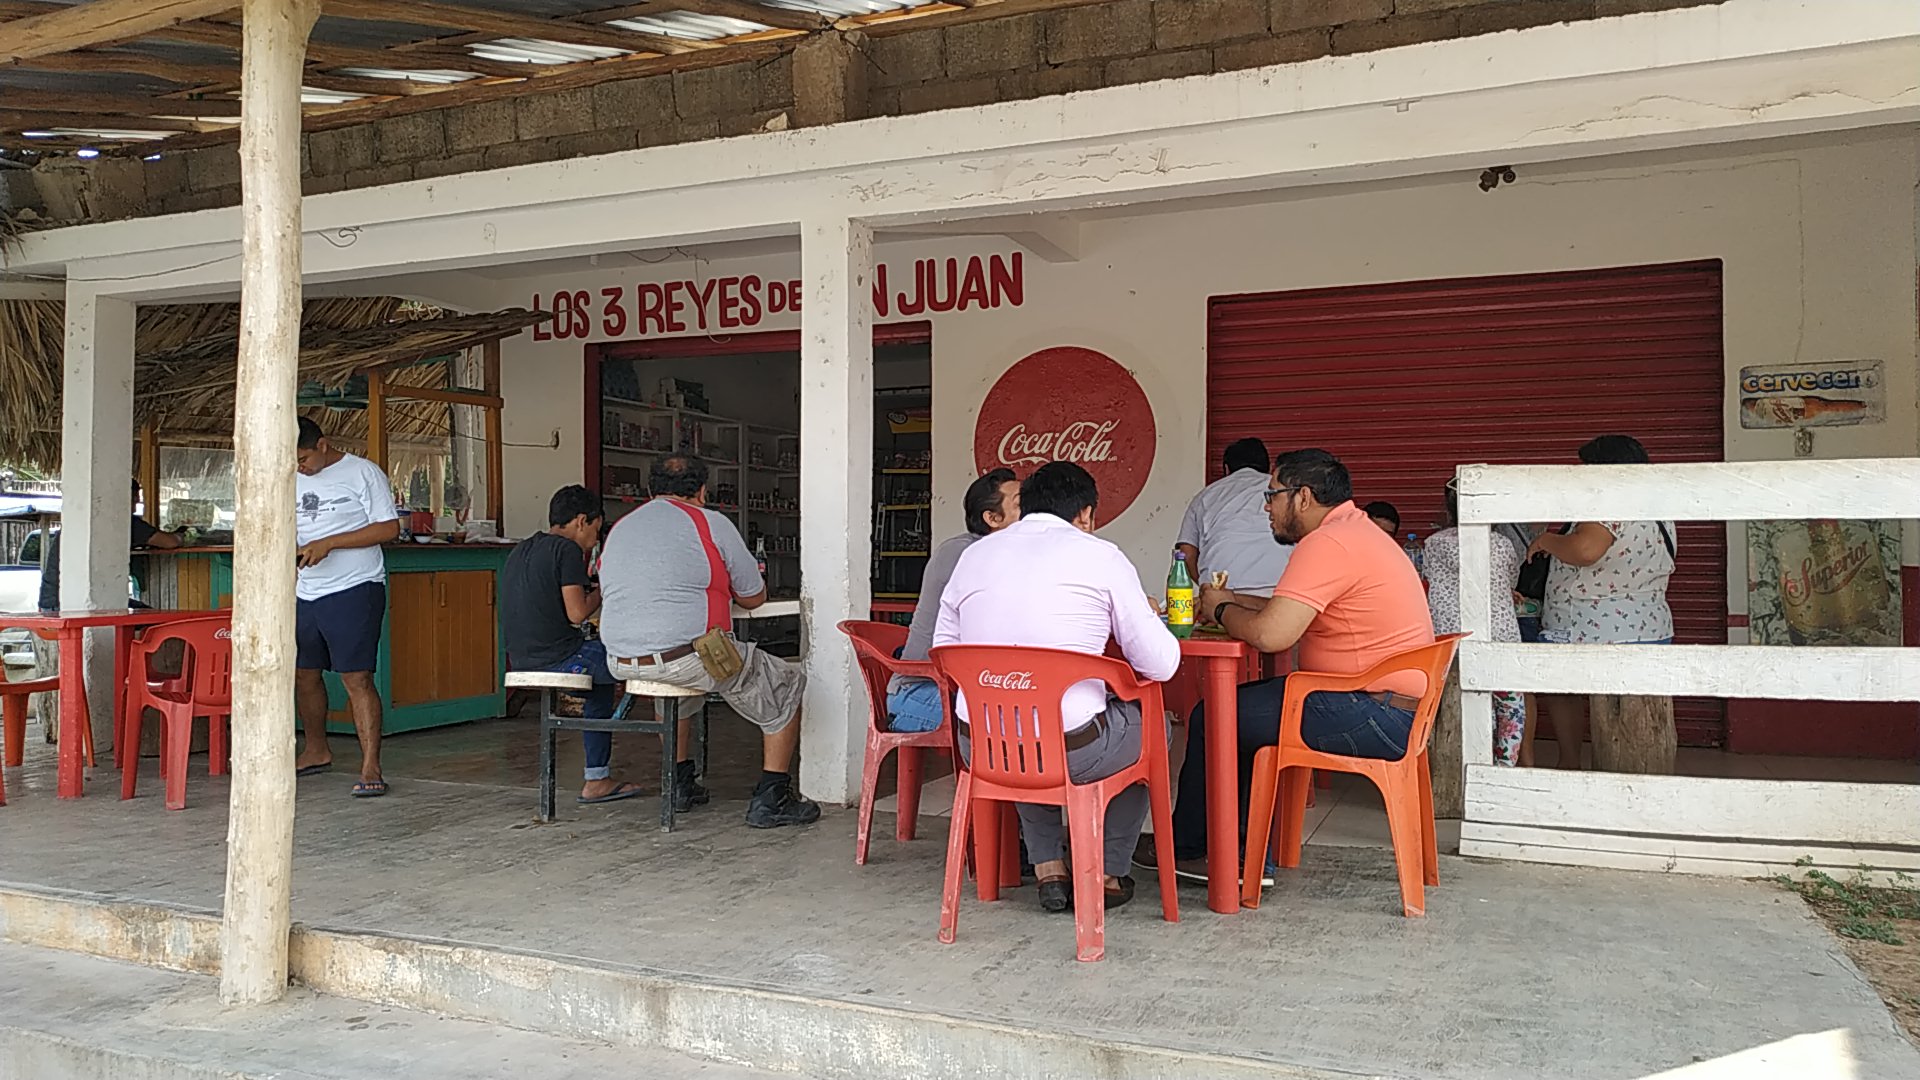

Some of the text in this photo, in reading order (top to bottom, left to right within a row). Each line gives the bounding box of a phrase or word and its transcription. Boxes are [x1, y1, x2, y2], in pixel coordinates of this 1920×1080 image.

[533, 290, 591, 341] LOS
[601, 286, 627, 337] 3
[638, 274, 762, 334] REYES
[768, 279, 802, 313] DE
[897, 252, 1024, 316] JUAN
[1742, 370, 1870, 392] cervecer
[997, 418, 1120, 465] Coca-Cola
[1784, 539, 1872, 607] Superior
[1168, 596, 1193, 614] FRESCA
[978, 669, 1034, 690] Coca-Cola
